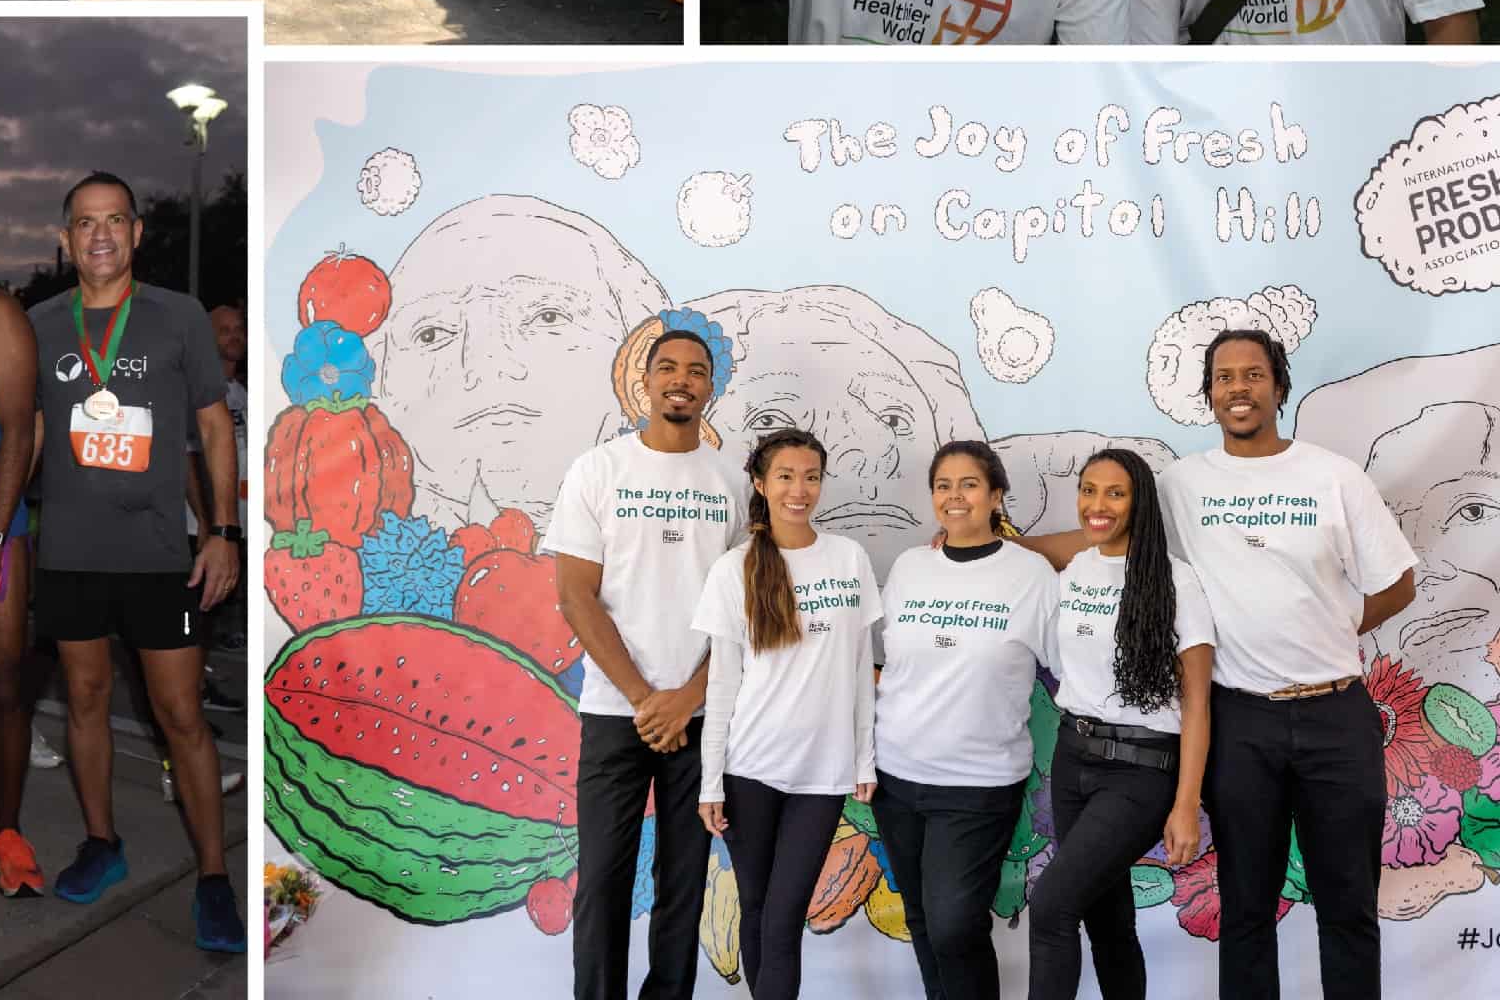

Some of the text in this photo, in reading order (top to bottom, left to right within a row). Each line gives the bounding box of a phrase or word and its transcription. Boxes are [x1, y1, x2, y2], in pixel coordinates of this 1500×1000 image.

[1239, 6, 1289, 25] World
[882, 18, 926, 45] World
[783, 101, 1308, 173] The Joy of Fresh
[830, 179, 1321, 263] on Capitol Hill
[85, 355, 148, 374] cci
[82, 432, 134, 467] 635
[616, 487, 728, 505] The Joy of Fresh
[1201, 493, 1318, 511] The Joy of Fresh
[615, 505, 729, 523] on Capitol Hill
[1201, 512, 1317, 529] on Capitol Hill
[794, 577, 861, 597] oy of Fresh
[1083, 585, 1099, 600] Joy
[1100, 585, 1112, 597] of
[796, 593, 861, 615] apitol Hill
[904, 599, 1011, 614] The Joy of Fresh
[1071, 598, 1117, 617] Capitol
[898, 612, 1009, 631] on Capitol Hill
